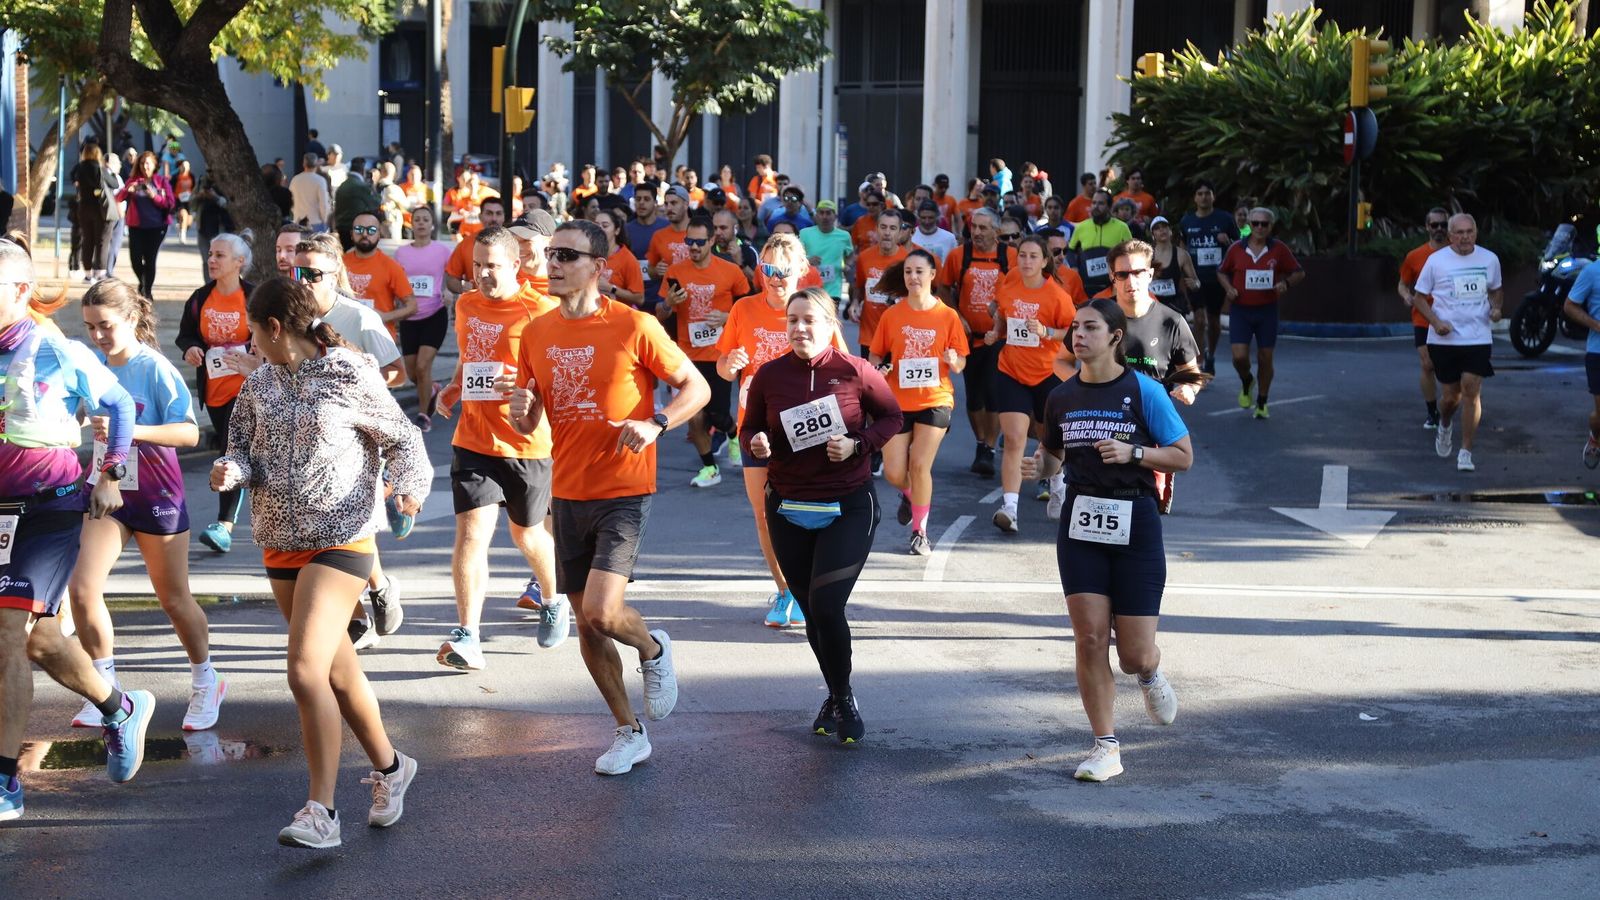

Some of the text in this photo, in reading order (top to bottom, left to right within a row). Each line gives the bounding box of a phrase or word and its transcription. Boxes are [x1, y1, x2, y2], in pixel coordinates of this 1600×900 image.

[1249, 276, 1270, 284] 1741
[1463, 283, 1478, 291] 10
[694, 327, 718, 340] 682
[1013, 327, 1028, 339] 16
[905, 368, 933, 380] 375
[466, 376, 495, 389] 345
[1065, 410, 1124, 419] TORREMOLINOS
[793, 412, 832, 438] 280
[1070, 420, 1094, 431] MEDIA
[1094, 420, 1137, 433] MARATÓN
[1113, 432, 1131, 441] 2024
[1078, 511, 1119, 531] 315
